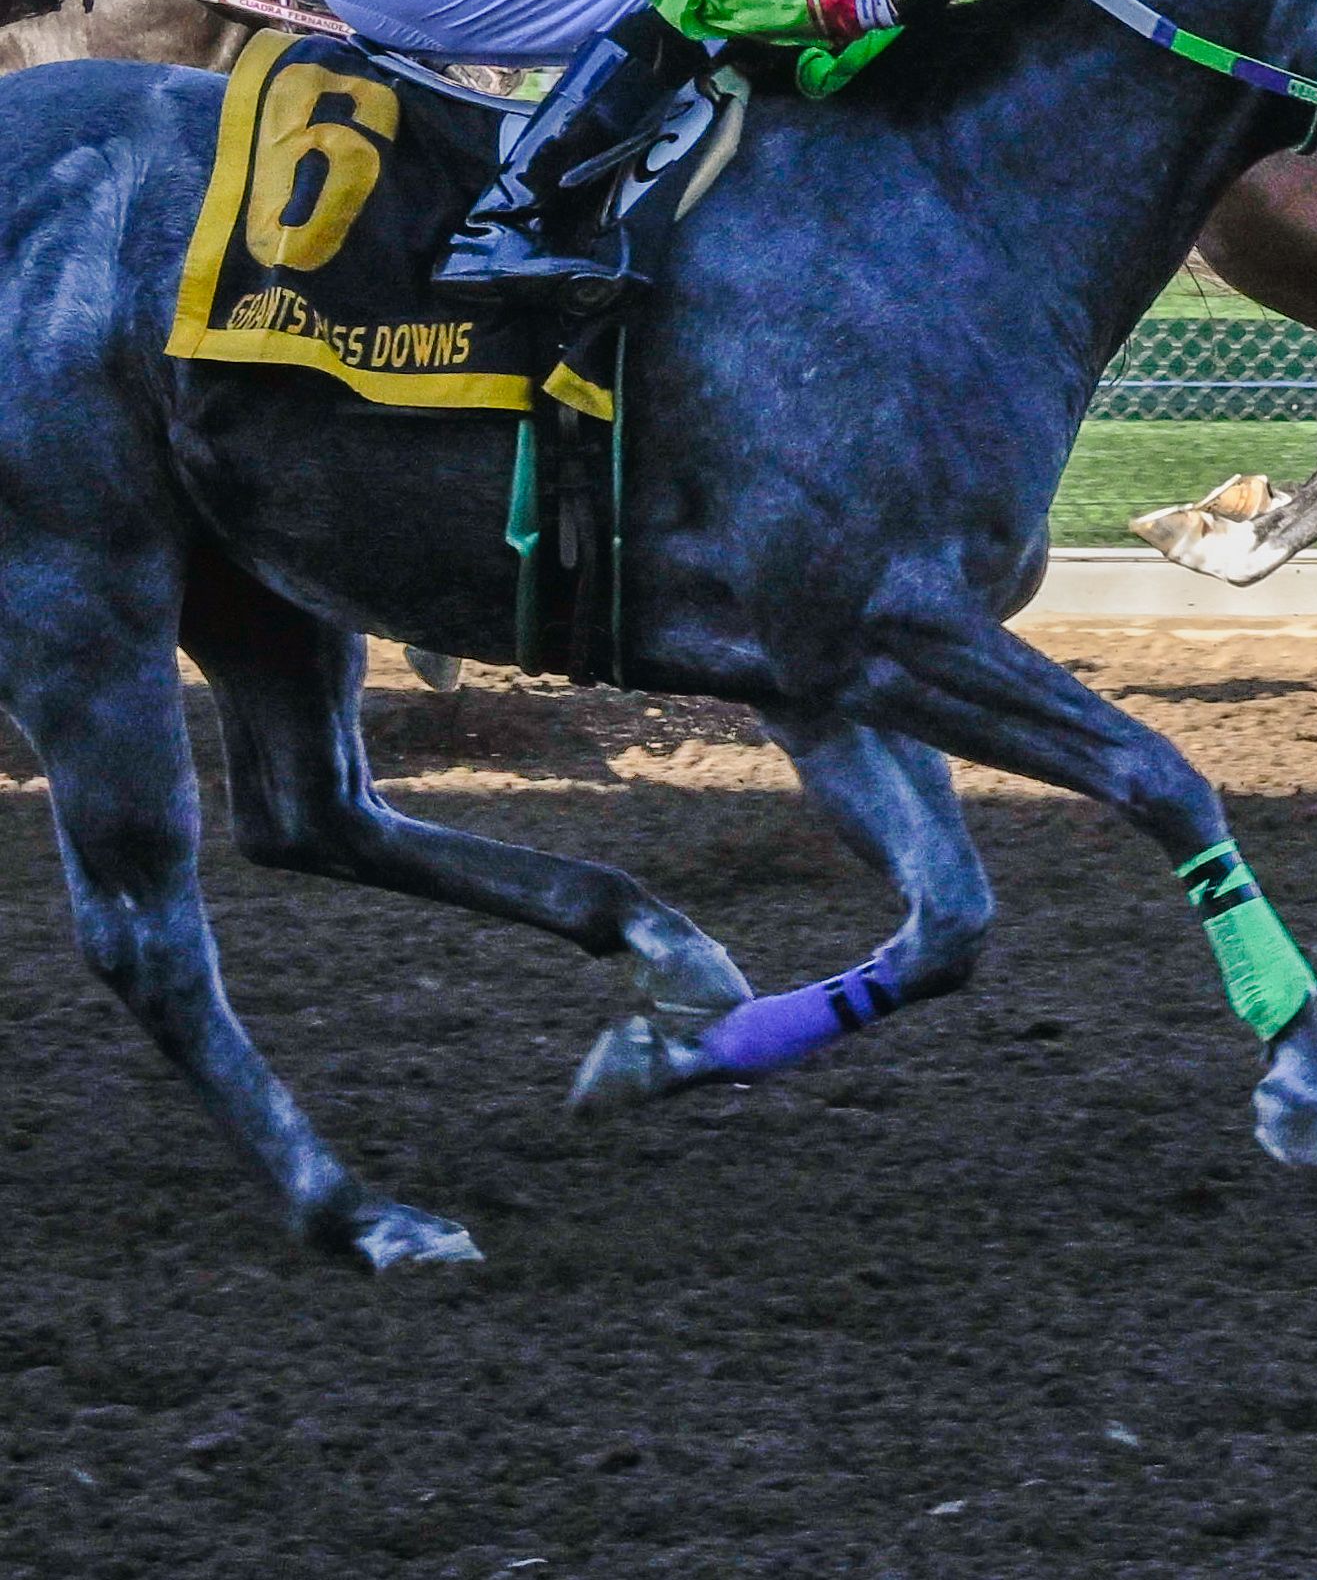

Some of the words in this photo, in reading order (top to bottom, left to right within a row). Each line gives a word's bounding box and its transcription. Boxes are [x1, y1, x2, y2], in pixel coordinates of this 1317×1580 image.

[287, 10, 352, 34] FERNANDEZ
[246, 62, 400, 272] 6
[371, 322, 473, 368] DOWNS
